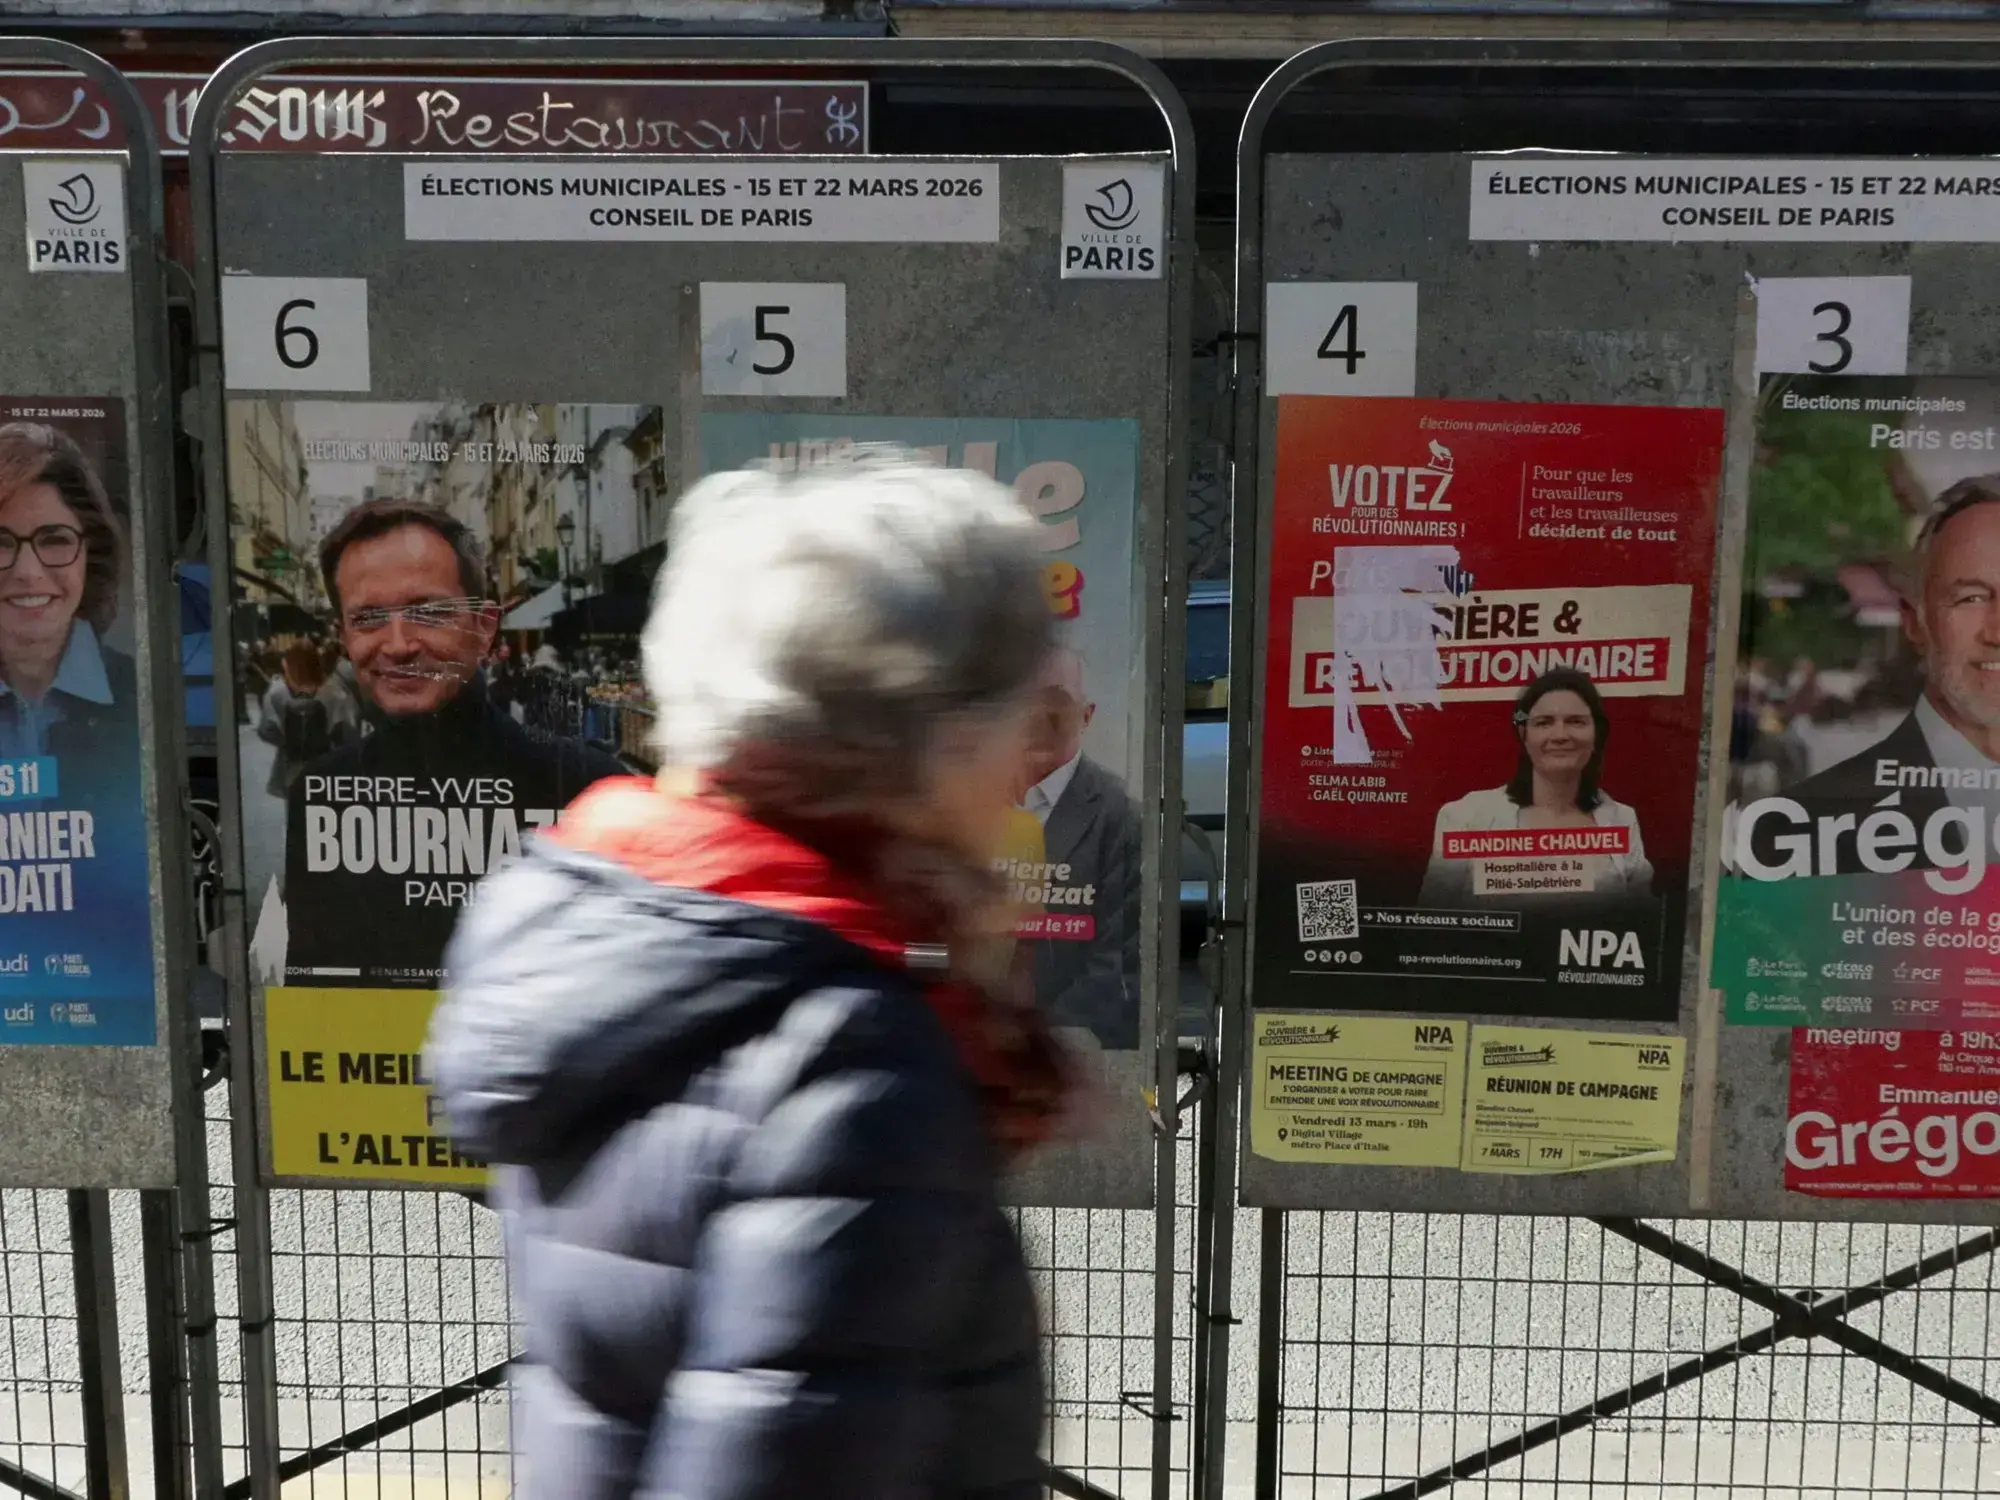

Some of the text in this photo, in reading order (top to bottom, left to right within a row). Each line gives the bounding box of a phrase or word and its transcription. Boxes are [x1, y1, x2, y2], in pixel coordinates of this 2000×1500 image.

[409, 90, 805, 150] Restaurant
[421, 173, 554, 197] ÉLECTIONS
[561, 177, 726, 197] MUNICIPALES
[748, 178, 771, 197] 15
[779, 178, 807, 197] ET
[814, 178, 842, 197] 22
[849, 178, 919, 198] MARS
[926, 178, 983, 198] 2026
[1488, 172, 1627, 195] ÉLECTIONS
[1634, 176, 1807, 196] MUNICIPALES
[1830, 177, 1853, 195] 15
[1862, 177, 1892, 196] ET
[1898, 177, 1927, 196] 22
[589, 208, 813, 227] CONSEIL DE PARIS
[1662, 207, 1895, 227] CONSEIL DE PARIS
[48, 228, 107, 238] VILLE DE
[1081, 233, 1142, 245] VILLE DE
[35, 240, 120, 264] PARIS
[1065, 246, 1155, 271] PARIS
[274, 299, 319, 369] 6
[752, 305, 795, 375] 5
[1317, 304, 1366, 375] 4
[1807, 301, 1853, 374] 3
[11, 408, 105, 418] 15 ET 22 MARS 2026
[1782, 391, 1966, 415] Élections municipales
[1420, 417, 1581, 435] Élections municipales 2026
[1869, 423, 1996, 450] Paris est
[369, 442, 449, 462] MUNICIPALES
[463, 443, 476, 462] 15
[479, 443, 493, 462] ET
[496, 443, 512, 463] 22
[553, 444, 585, 464] 2026
[1532, 465, 1633, 485] Pour que les
[1329, 463, 1453, 511] VOTEZ
[1531, 486, 1623, 502] travailleurs
[1351, 506, 1399, 519] POUR DES
[1530, 505, 1679, 524] et les travailleuses
[1312, 516, 1457, 538] RÉVOLUTIONNAIRES
[1529, 524, 1677, 542] décident de tout
[1553, 600, 1582, 635] &
[18, 762, 39, 795] 11
[1308, 774, 1386, 788] SELMA LABIB
[305, 775, 514, 805] PIERRE-YVES
[1313, 787, 1409, 804] GAËL QUIRANTE
[305, 805, 563, 874] BOURNA
[1447, 831, 1624, 854] BLANDINE CHAUVEL
[1735, 790, 2000, 895] Grég
[1484, 859, 1583, 874] Hospitalière la
[1486, 874, 1582, 890] Pitié-Salpêtrière
[1376, 911, 1514, 928] Nos réseaux sociaux
[1832, 902, 1980, 926] L'union de la
[1046, 918, 1061, 933] le
[1842, 927, 1864, 945] et
[1872, 926, 1915, 947] des
[1558, 928, 1645, 969] NPA
[1399, 953, 1522, 970] npa-revolutionnaires.org
[370, 968, 449, 977] RENAISSANCE
[1558, 970, 1644, 986] RÉVOLUTIONNAIRES
[1910, 968, 1941, 981] PCF
[4, 1001, 35, 1022] udi
[1910, 1000, 1940, 1013] PCF
[1415, 1026, 1453, 1044] NPA
[1806, 1028, 1901, 1050] meeting
[1939, 1030, 1953, 1048] à
[280, 1051, 325, 1082] LE
[1638, 1049, 1670, 1066] NPA
[1938, 1051, 1994, 1065] Au Cirque
[1269, 1065, 1443, 1085] MEETING DE CAMPAGNE
[1348, 1087, 1375, 1096] VOTER
[1377, 1088, 1402, 1096] POUR
[1404, 1088, 1428, 1097] FAIRE
[1486, 1075, 1658, 1100] RÉUNION DE CAMPAGNE
[1270, 1096, 1439, 1109] ENTENDRE UNE VOIX RÉVOLUTIONNAIRE
[1292, 1114, 1345, 1126] Vendredi
[1365, 1119, 1397, 1128] mars
[1407, 1118, 1428, 1129] 19h
[1291, 1128, 1363, 1140] Digital Village
[318, 1132, 487, 1168] L'ALTE
[1291, 1140, 1390, 1151] métro Place d'Italie
[1489, 1148, 1521, 1158] MARS
[1540, 1147, 1563, 1159] 17H
